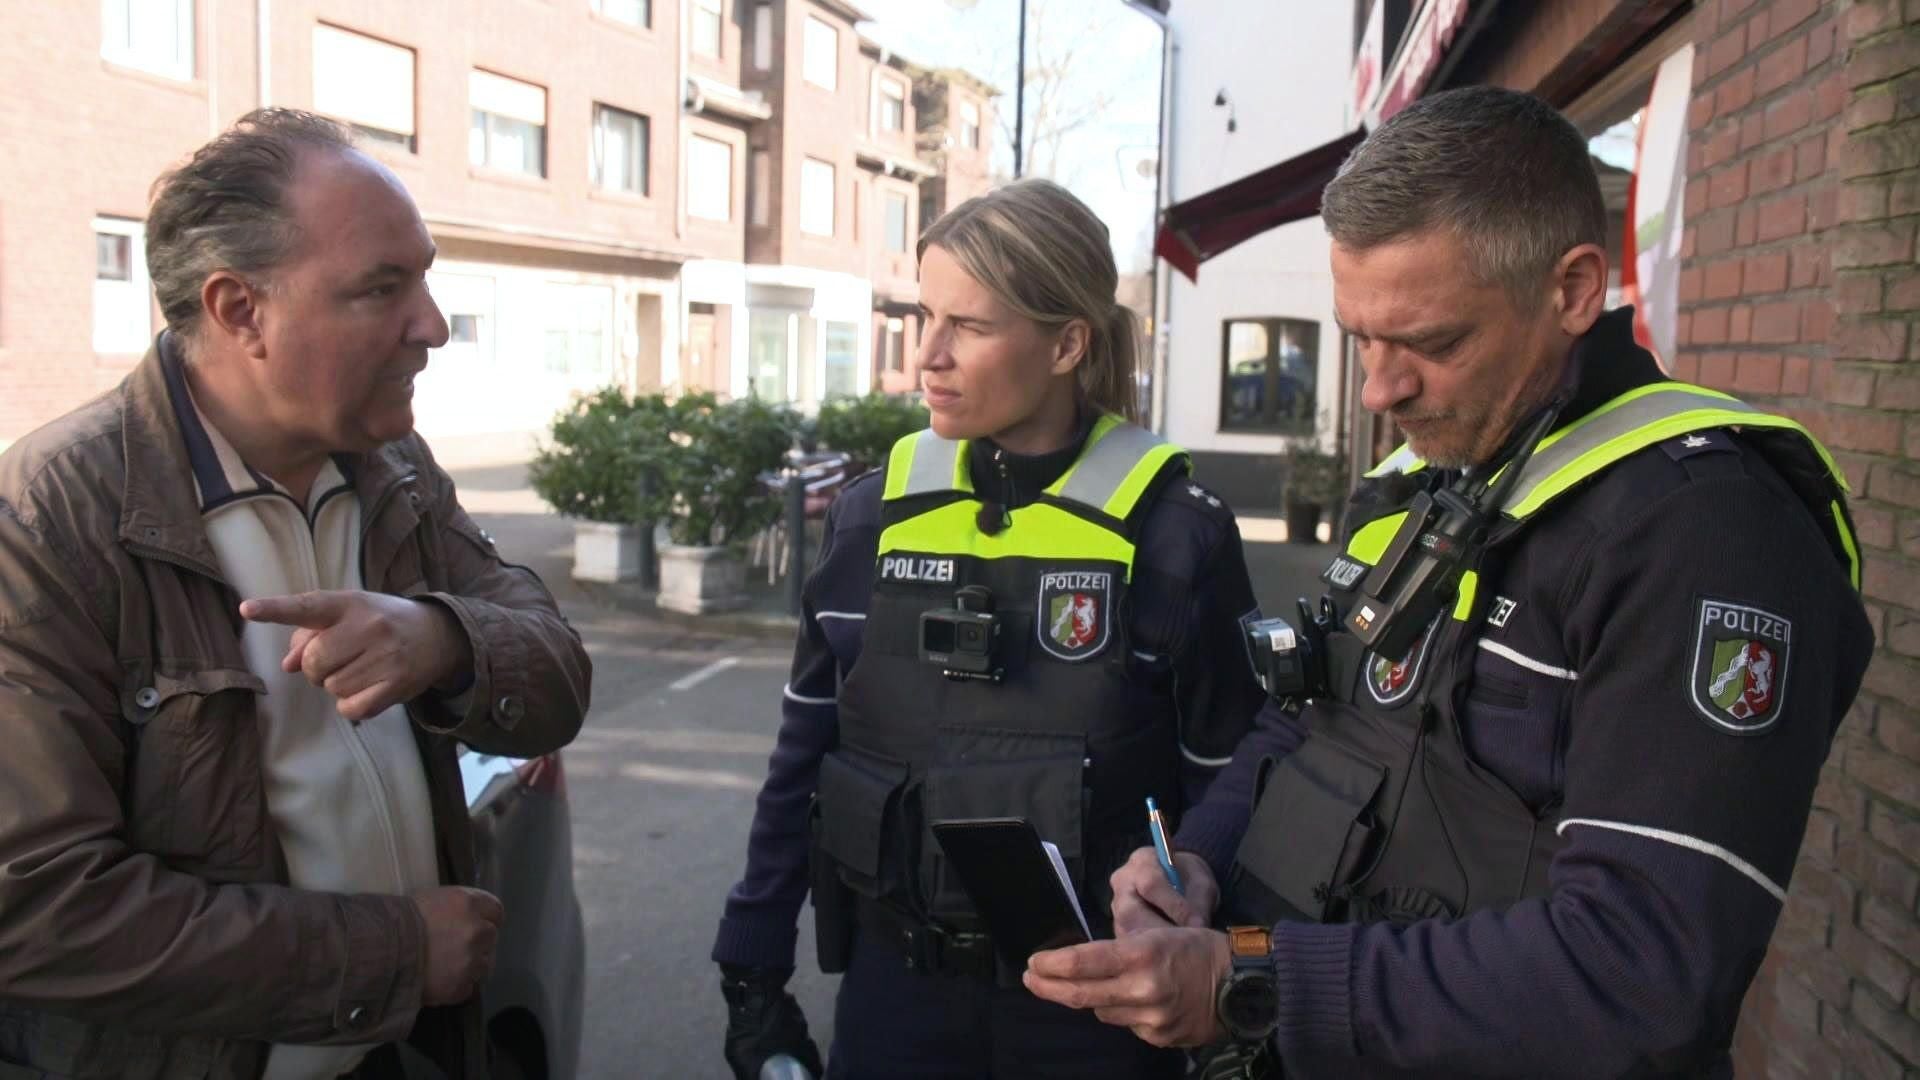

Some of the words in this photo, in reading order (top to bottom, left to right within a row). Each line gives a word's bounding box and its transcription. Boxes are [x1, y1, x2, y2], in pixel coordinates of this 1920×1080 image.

[881, 557, 954, 582] POLIZEI
[1045, 575, 1106, 590] POLIZEI
[1487, 595, 1517, 628] ZEI
[1705, 607, 1788, 643] POLIZEI
